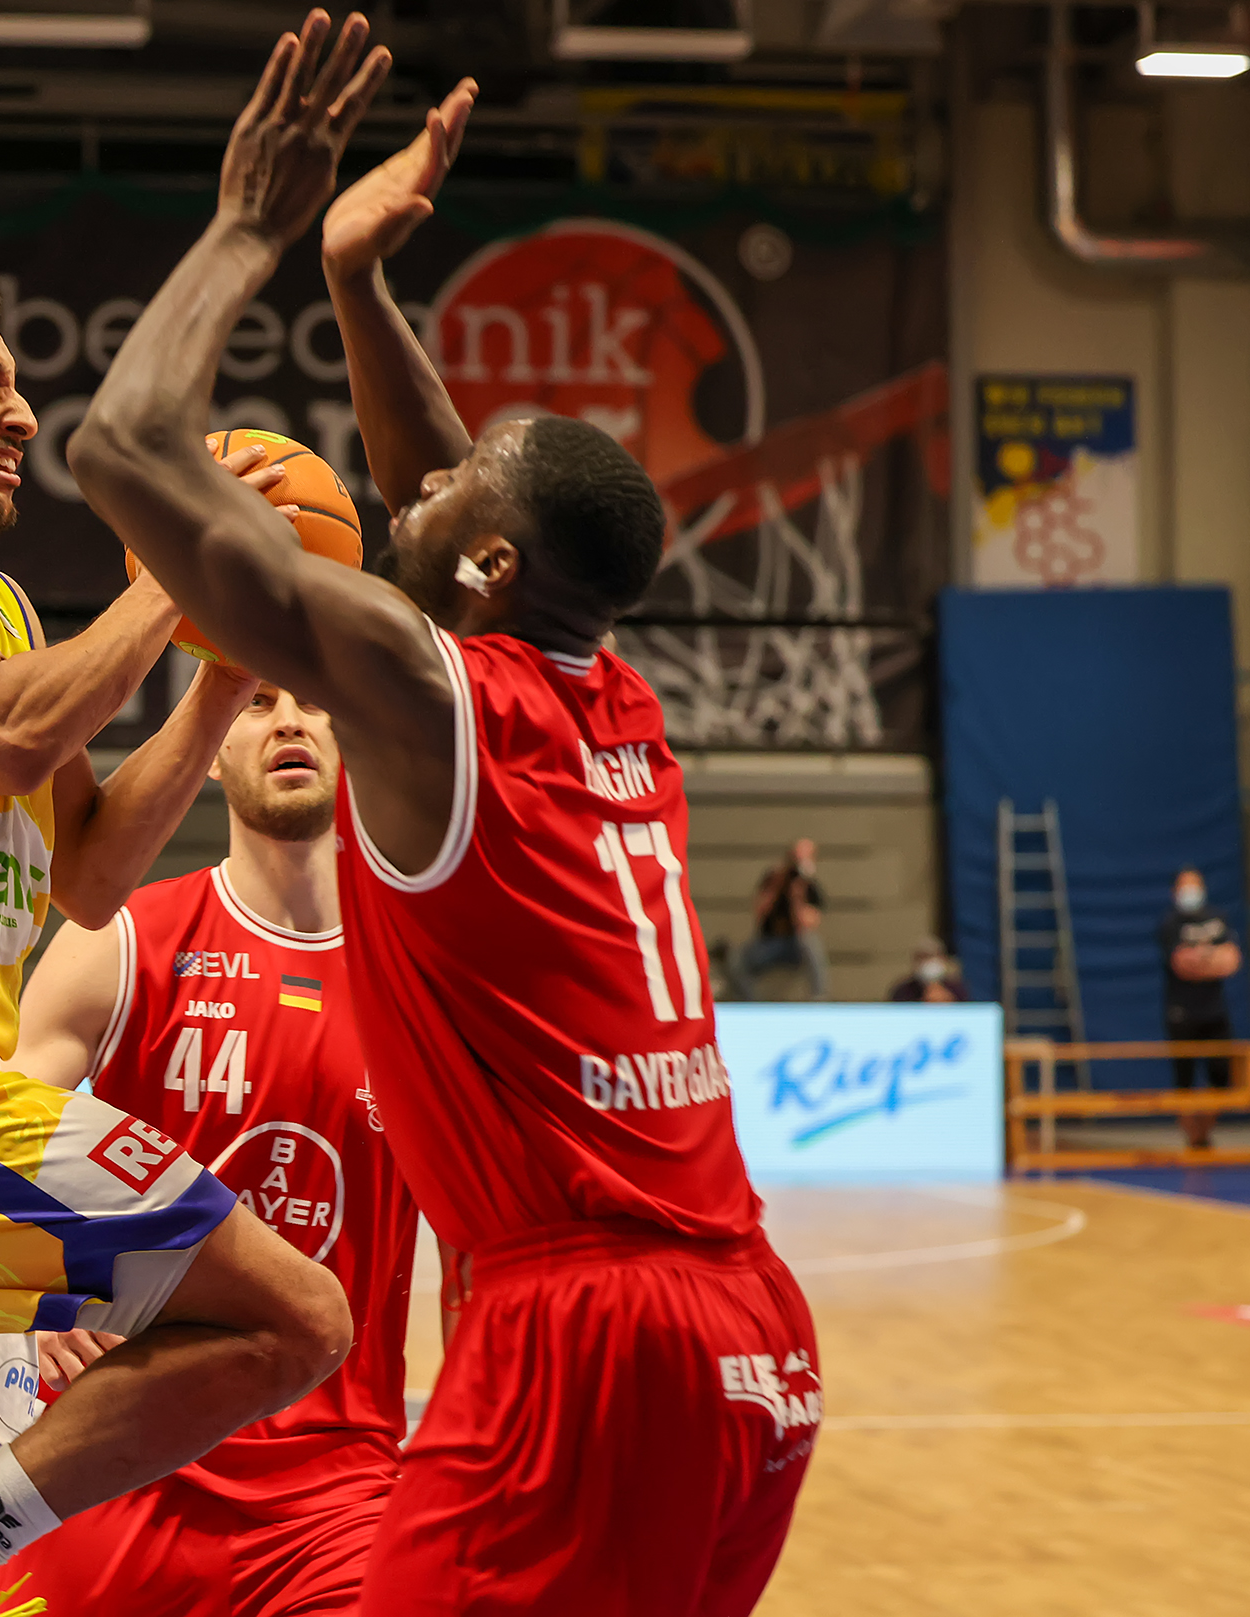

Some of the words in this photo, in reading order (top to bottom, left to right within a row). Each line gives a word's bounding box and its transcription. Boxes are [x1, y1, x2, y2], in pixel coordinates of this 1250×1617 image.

[594, 820, 705, 1023] 17
[201, 951, 261, 980] EVL
[185, 999, 236, 1019] JAKO
[163, 1026, 252, 1115] 44
[237, 1189, 331, 1227] AYER
